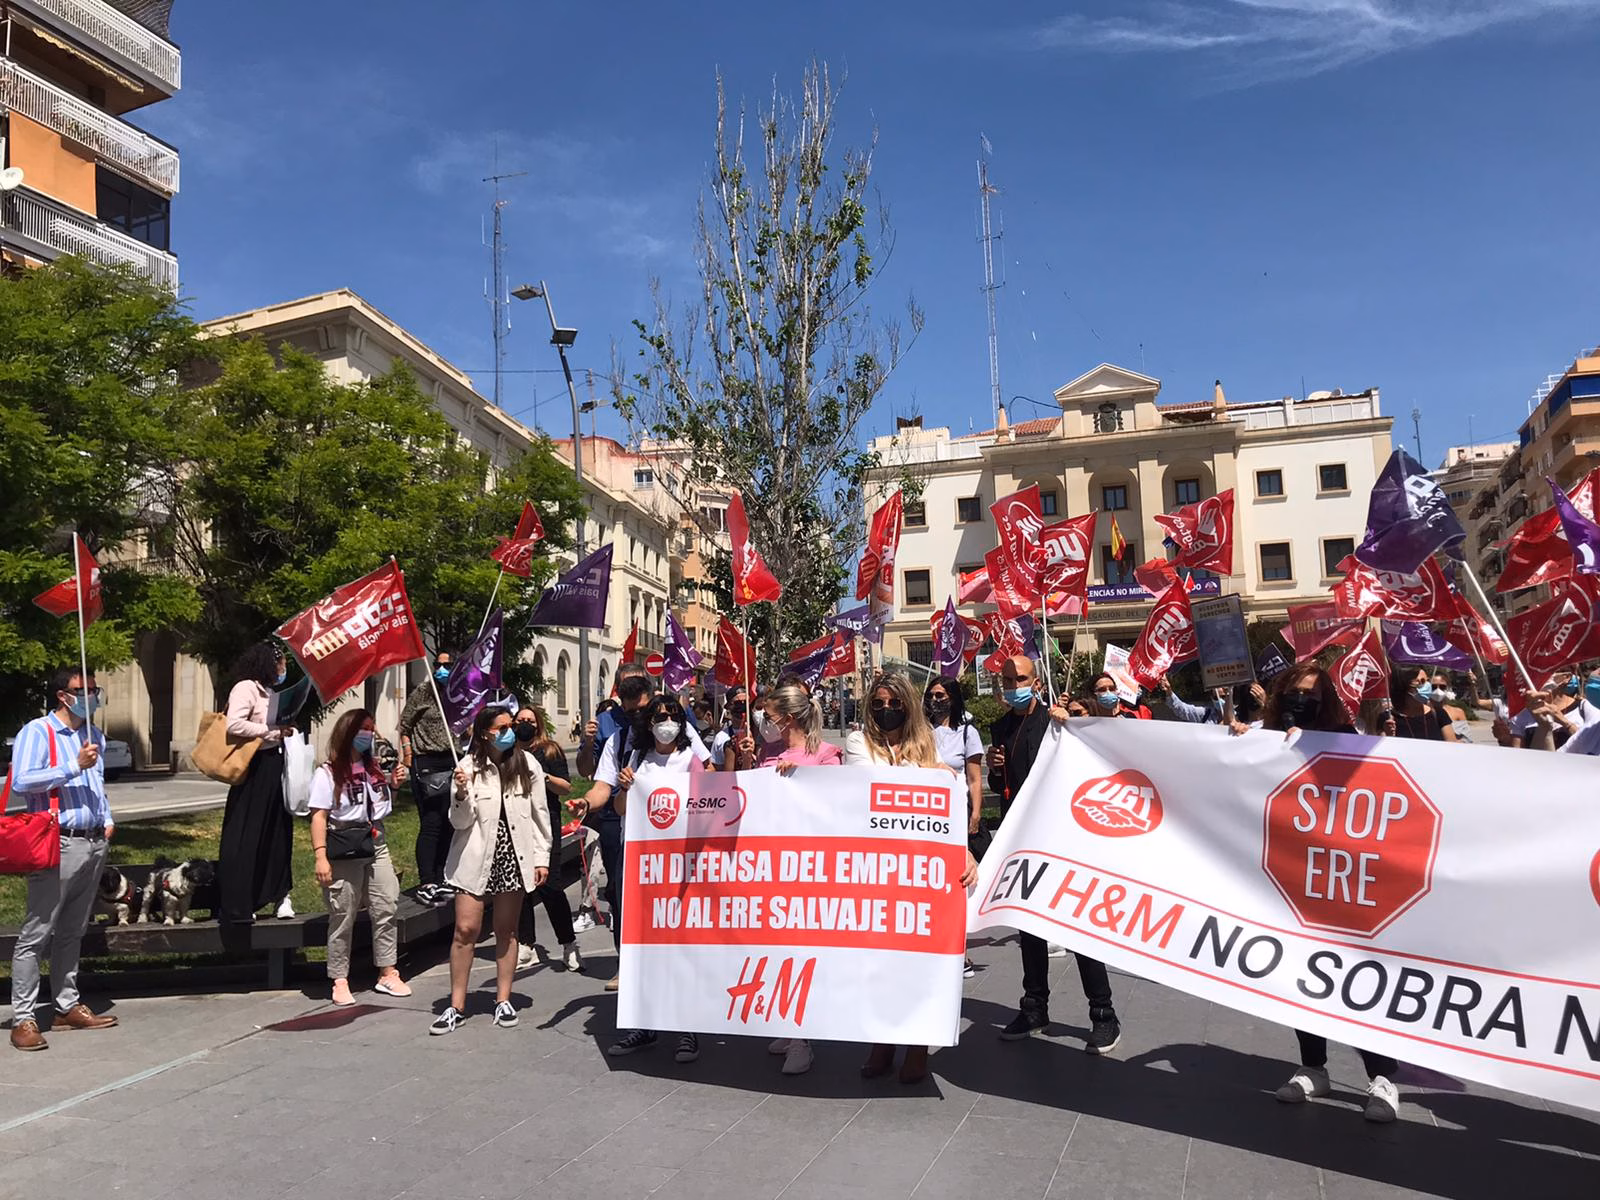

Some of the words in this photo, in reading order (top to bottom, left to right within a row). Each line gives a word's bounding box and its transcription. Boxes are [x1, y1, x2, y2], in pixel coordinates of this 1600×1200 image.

[1116, 587, 1127, 597] NO
[651, 792, 678, 811] UGT
[686, 797, 727, 809] FeSMC
[876, 789, 946, 810] CCOO
[1087, 779, 1154, 815] UGT
[1293, 783, 1409, 842] STOP
[870, 816, 950, 835] servicios
[639, 853, 663, 885] EN
[668, 850, 773, 884] DEFENSA
[779, 851, 828, 884] DEL
[835, 851, 952, 894] EMPLEO,
[1305, 846, 1377, 907] ERE
[652, 896, 682, 929] NO
[686, 896, 714, 929] AL
[719, 896, 762, 929] ERE
[768, 896, 888, 933] SALVAJE
[895, 902, 932, 937] DE
[988, 858, 1050, 903] EN
[1047, 869, 1186, 950] H&M
[1189, 915, 1284, 979] NO
[1296, 950, 1528, 1049] SOBRA
[1554, 994, 1600, 1062] N
[726, 955, 817, 1027] H&M
